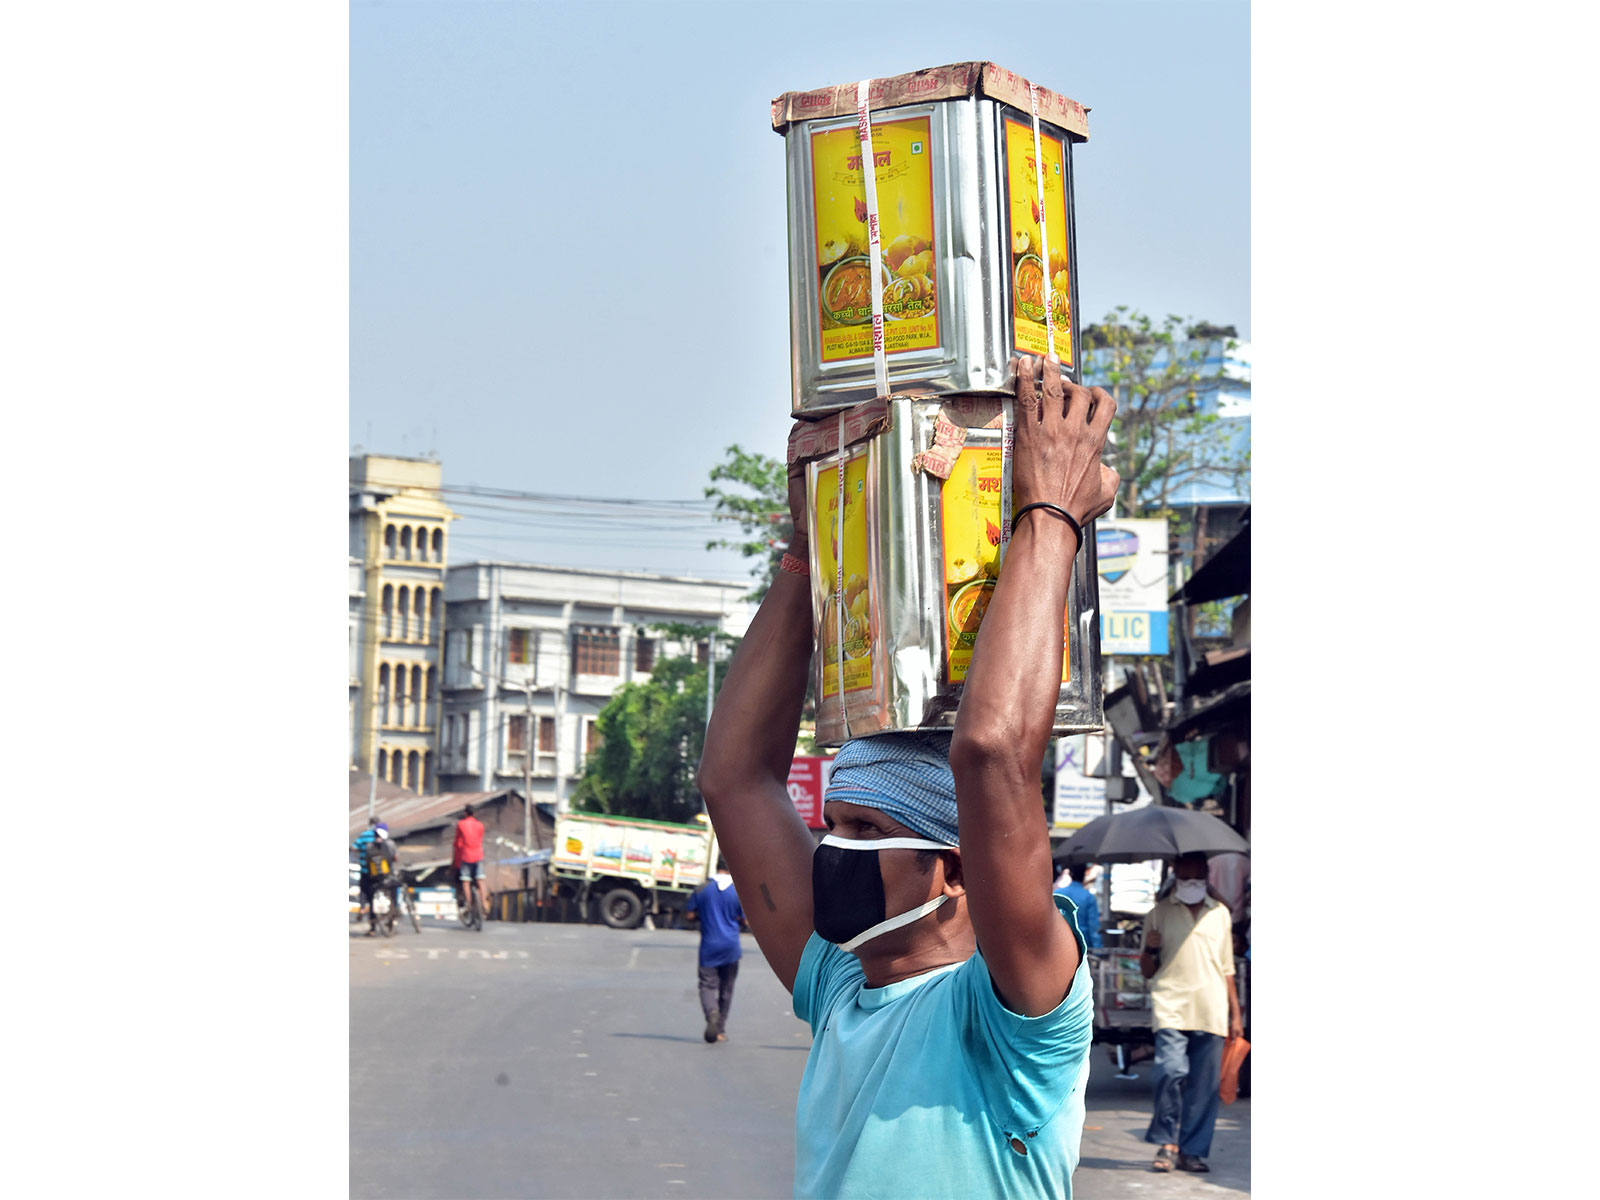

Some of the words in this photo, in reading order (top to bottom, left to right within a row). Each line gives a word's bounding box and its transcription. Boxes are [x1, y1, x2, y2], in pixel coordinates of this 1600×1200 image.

[858, 103, 868, 141] MASHAL
[847, 151, 891, 171] माल
[907, 298, 922, 310] तेल
[873, 314, 882, 352] मशाल
[1004, 423, 1014, 458] MASHAL
[1109, 617, 1144, 639] LIC
